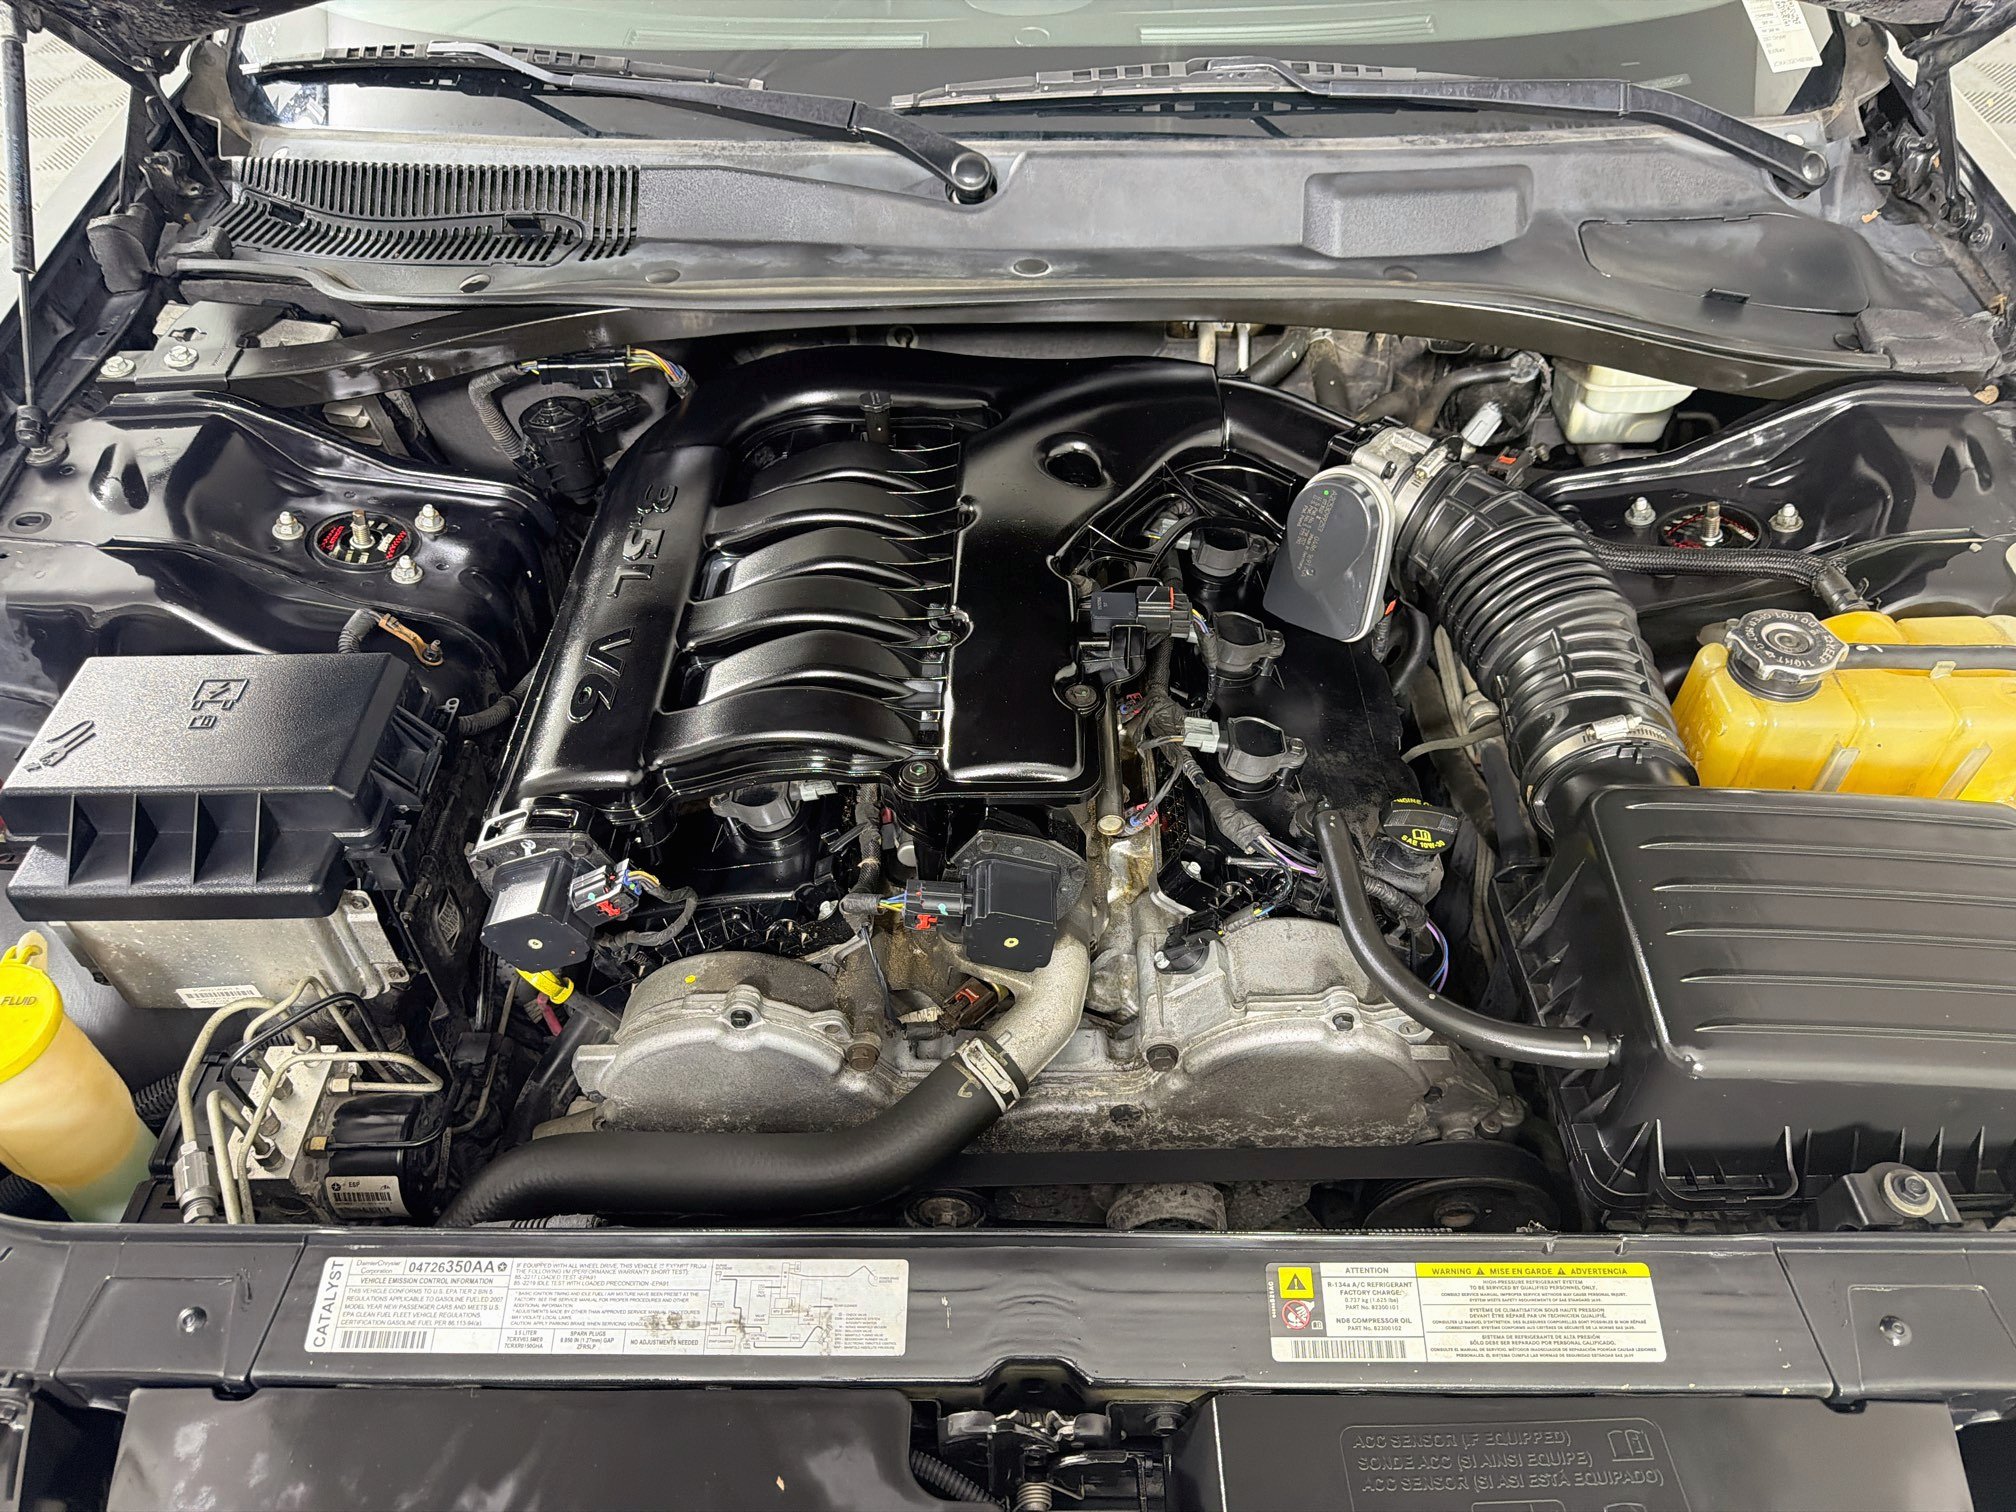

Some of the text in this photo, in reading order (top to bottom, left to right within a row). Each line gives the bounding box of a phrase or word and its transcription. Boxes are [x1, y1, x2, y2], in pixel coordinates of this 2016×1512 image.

[567, 484, 678, 723] 3.5L V6
[1401, 834, 1418, 846] SAE
[1, 996, 37, 1005] FLUID
[408, 1260, 494, 1273] 04726350AA
[313, 1260, 344, 1348] CATALYST
[1353, 1434, 1386, 1448] ACC
[1391, 1432, 1458, 1448] SENSOR
[1485, 1430, 1572, 1446] EQUIPPED)
[1358, 1450, 1593, 1471] SONDE ACC (SI AINSI EQUIPE)
[1362, 1478, 1396, 1492] ACC
[1400, 1474, 1469, 1491] SENSOR
[1474, 1474, 1494, 1493] (SI
[1529, 1470, 1570, 1488] ESTÁ
[1574, 1468, 1664, 1486] EQUIPADO)
